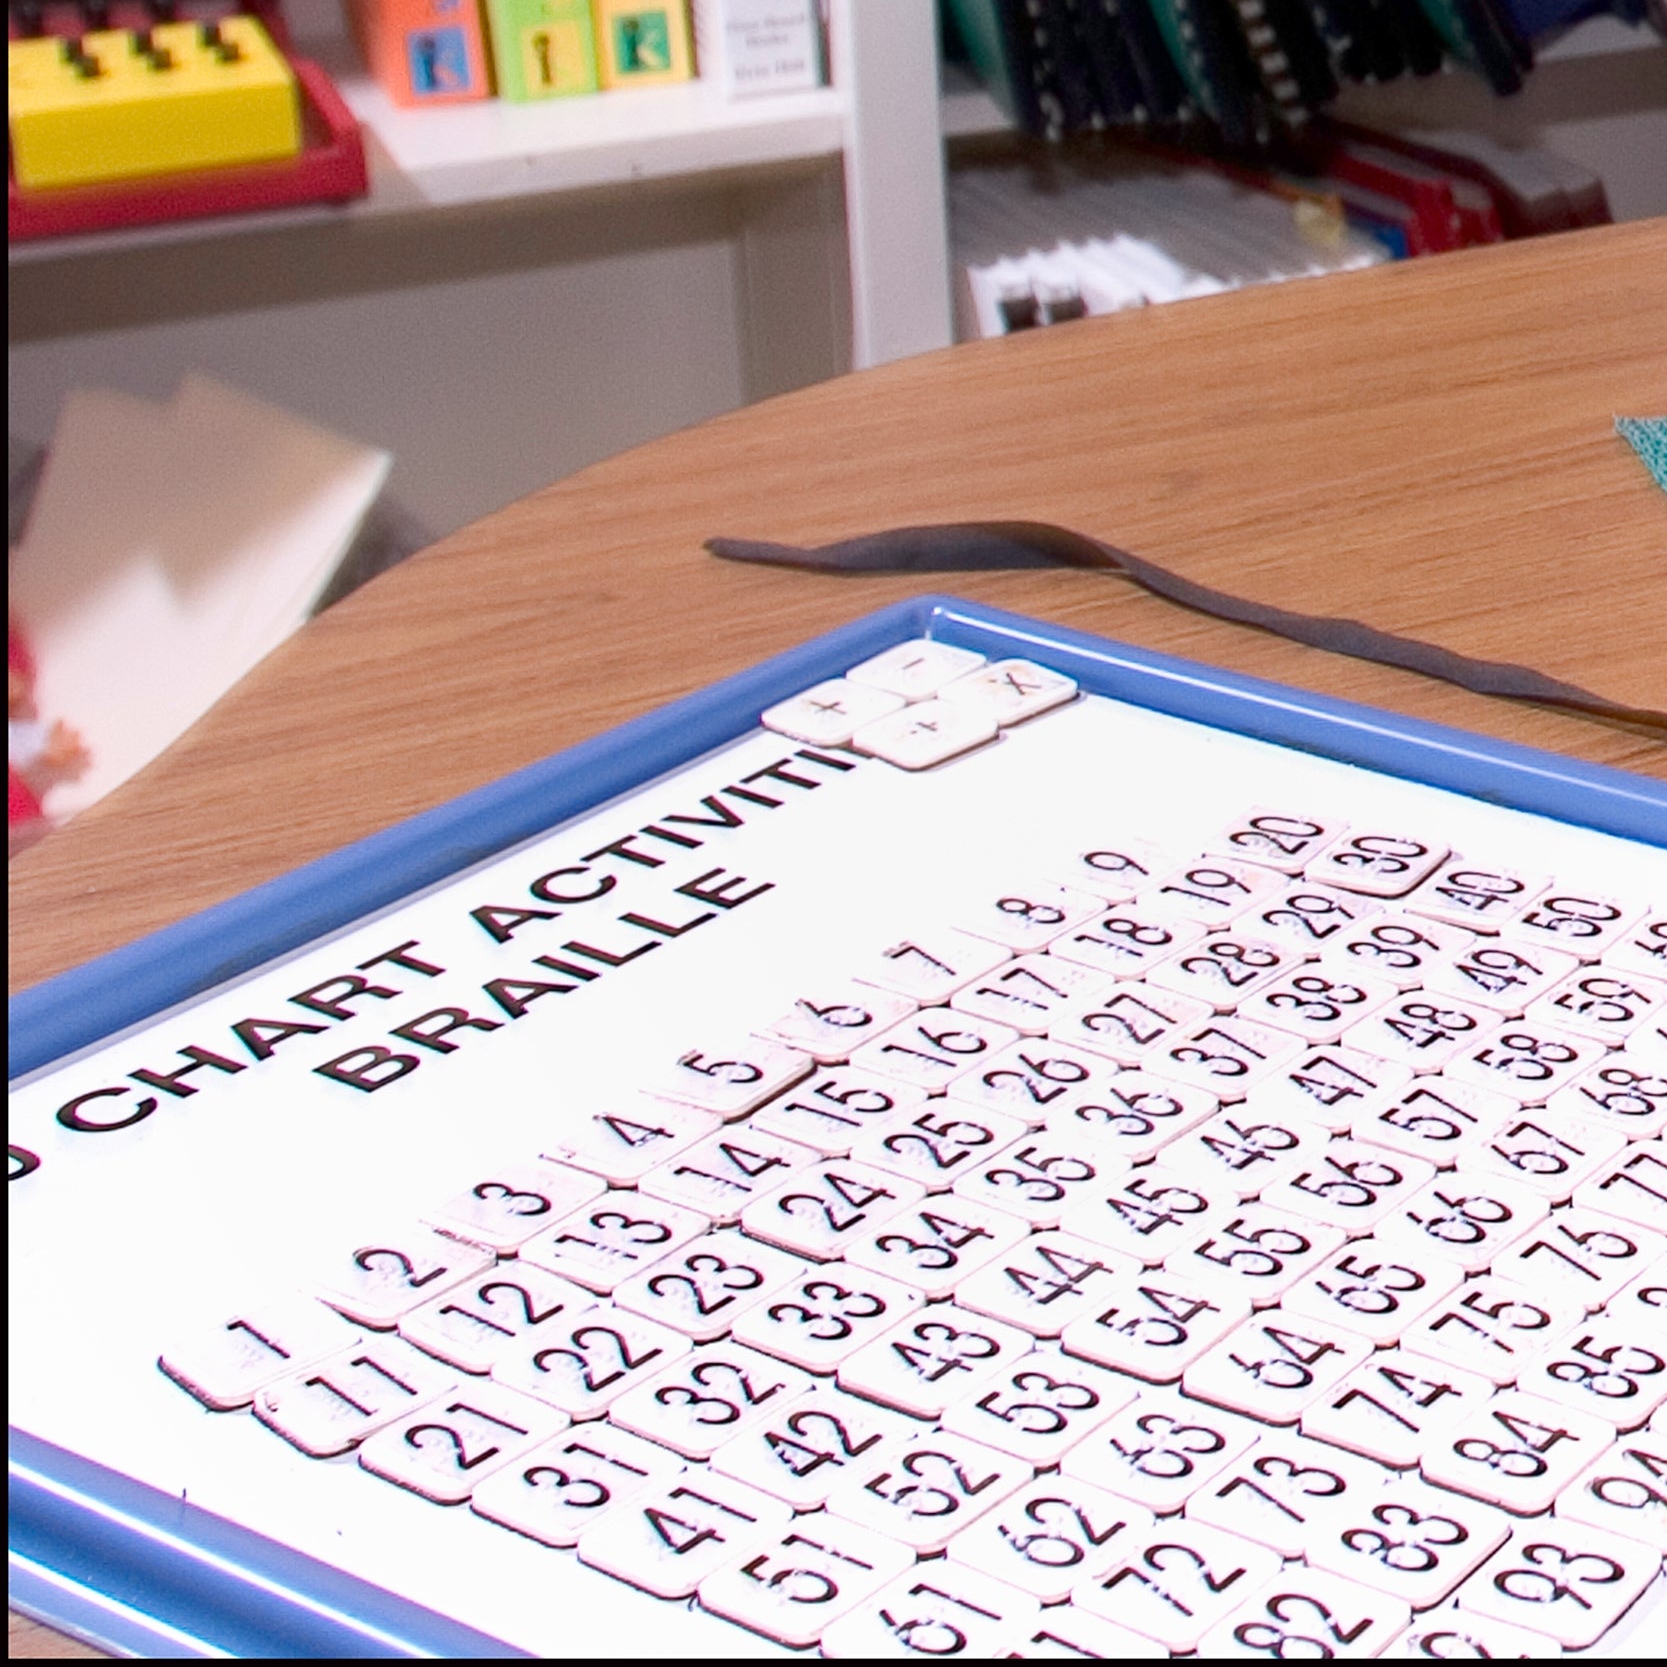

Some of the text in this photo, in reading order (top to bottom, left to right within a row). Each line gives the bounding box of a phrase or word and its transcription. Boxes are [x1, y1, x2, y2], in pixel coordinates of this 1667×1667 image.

[56, 746, 873, 1134] CHART ACTIVITI
[227, 851, 1150, 1360] 1 2 3 4 5 6 7 8 9
[304, 816, 1325, 1417] 11 12 13 14 15 16 17 18 19 20
[313, 867, 776, 1094] BRAILLE
[404, 836, 1429, 1471] 21 22 23 24 25 26 27 28 29 30
[522, 870, 1525, 1509] 31 32 33 34 35 36 37 38 39 40
[643, 896, 1622, 1555] 41 42 43 44 45 46 47 48 49 50
[741, 1533, 874, 1604] 51
[863, 1450, 1001, 1517] 52
[975, 1371, 1100, 1435] 53
[1095, 1285, 1221, 1347] 54
[1193, 1218, 1312, 1277] 55
[1289, 1155, 1404, 1208] 56
[1378, 1088, 1479, 1141] 57
[1472, 1033, 1579, 1081] 58
[1553, 977, 1652, 1023] 59
[879, 1582, 1002, 1656] 61
[997, 1497, 1127, 1568] 62
[1109, 1414, 1227, 1479] 63
[1228, 1326, 1346, 1390] 64
[1315, 1255, 1427, 1315] 65
[1406, 1190, 1514, 1245] 66
[1490, 1121, 1586, 1175] 67
[1101, 1543, 1247, 1617] 72
[1215, 1456, 1347, 1524] 73
[1331, 1366, 1463, 1434] 74
[1428, 1290, 1552, 1354] 75
[1519, 1224, 1638, 1282] 76
[1342, 1503, 1470, 1573] 83
[1452, 1410, 1581, 1478] 84
[1546, 1335, 1667, 1399] 85
[1493, 1543, 1626, 1610] 93
